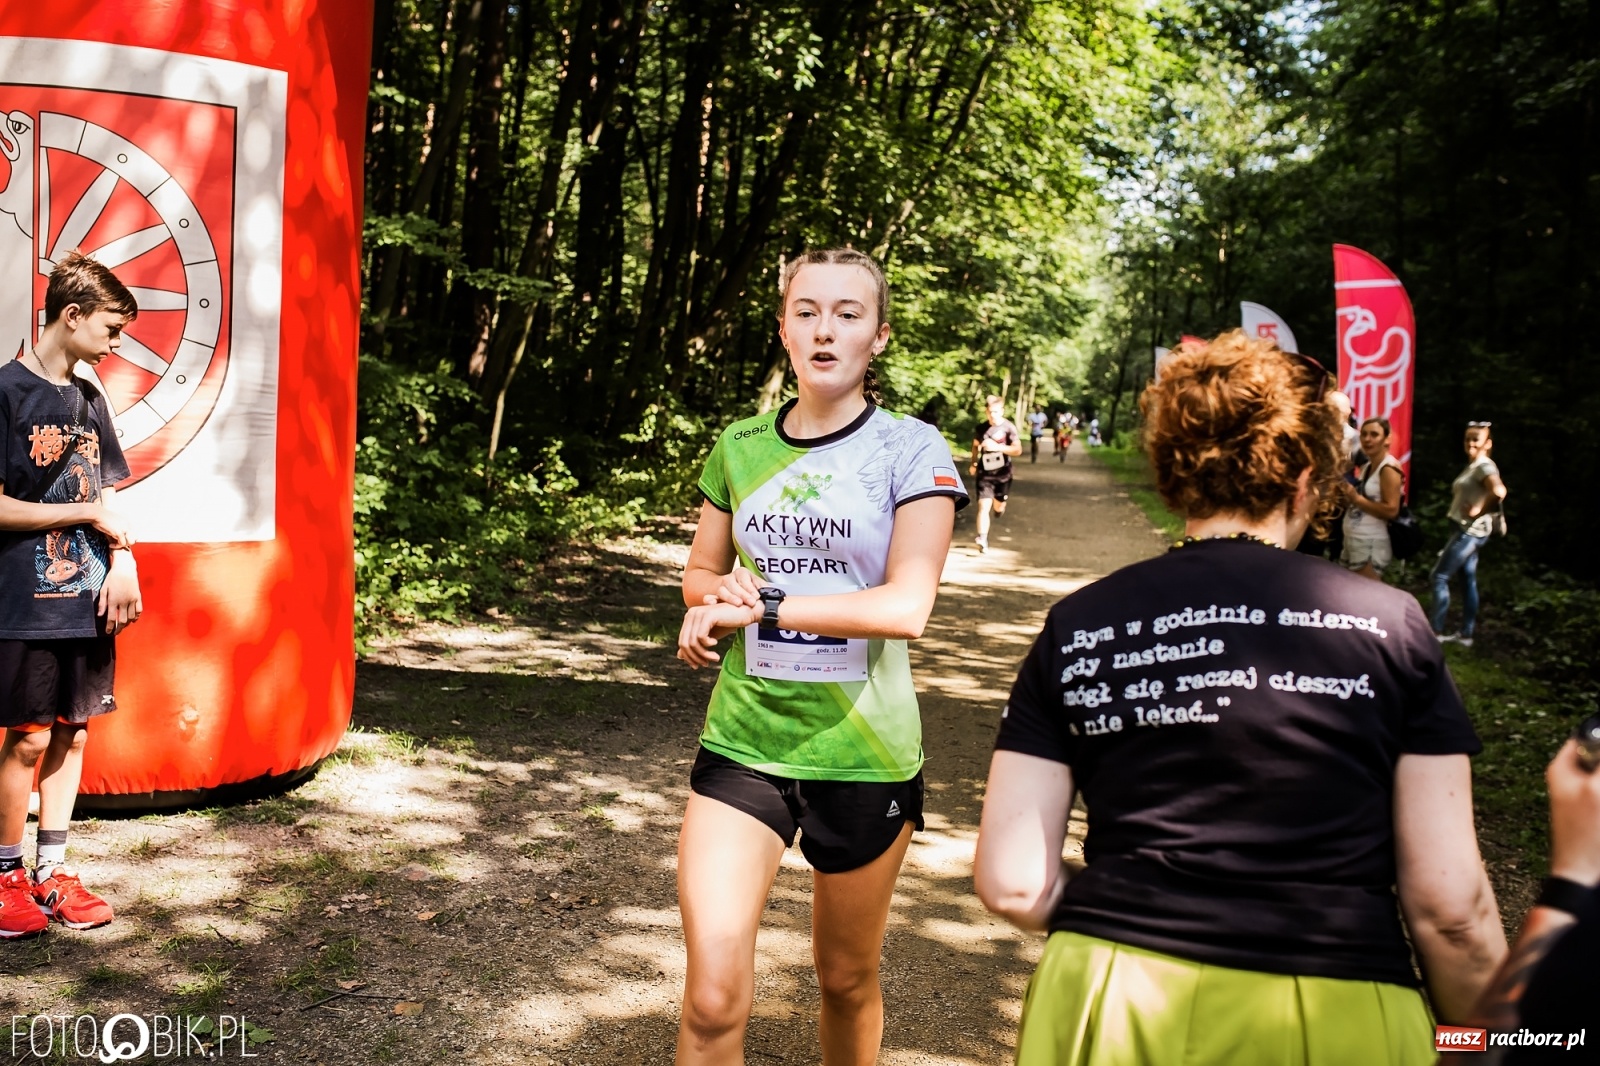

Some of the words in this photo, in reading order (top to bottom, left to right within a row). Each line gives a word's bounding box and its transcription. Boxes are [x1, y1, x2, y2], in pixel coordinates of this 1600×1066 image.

[733, 423, 769, 441] deep
[745, 514, 851, 539] AKTYWNI
[768, 534, 830, 549] LYSKI
[754, 557, 848, 575] GEOFART
[1126, 620, 1142, 636] w
[1152, 604, 1266, 635] godzinie
[1060, 657, 1101, 684] gdy
[1112, 637, 1225, 669] nastanie
[1124, 678, 1165, 700] się
[1175, 666, 1258, 692] raczej
[1084, 714, 1124, 736] nie
